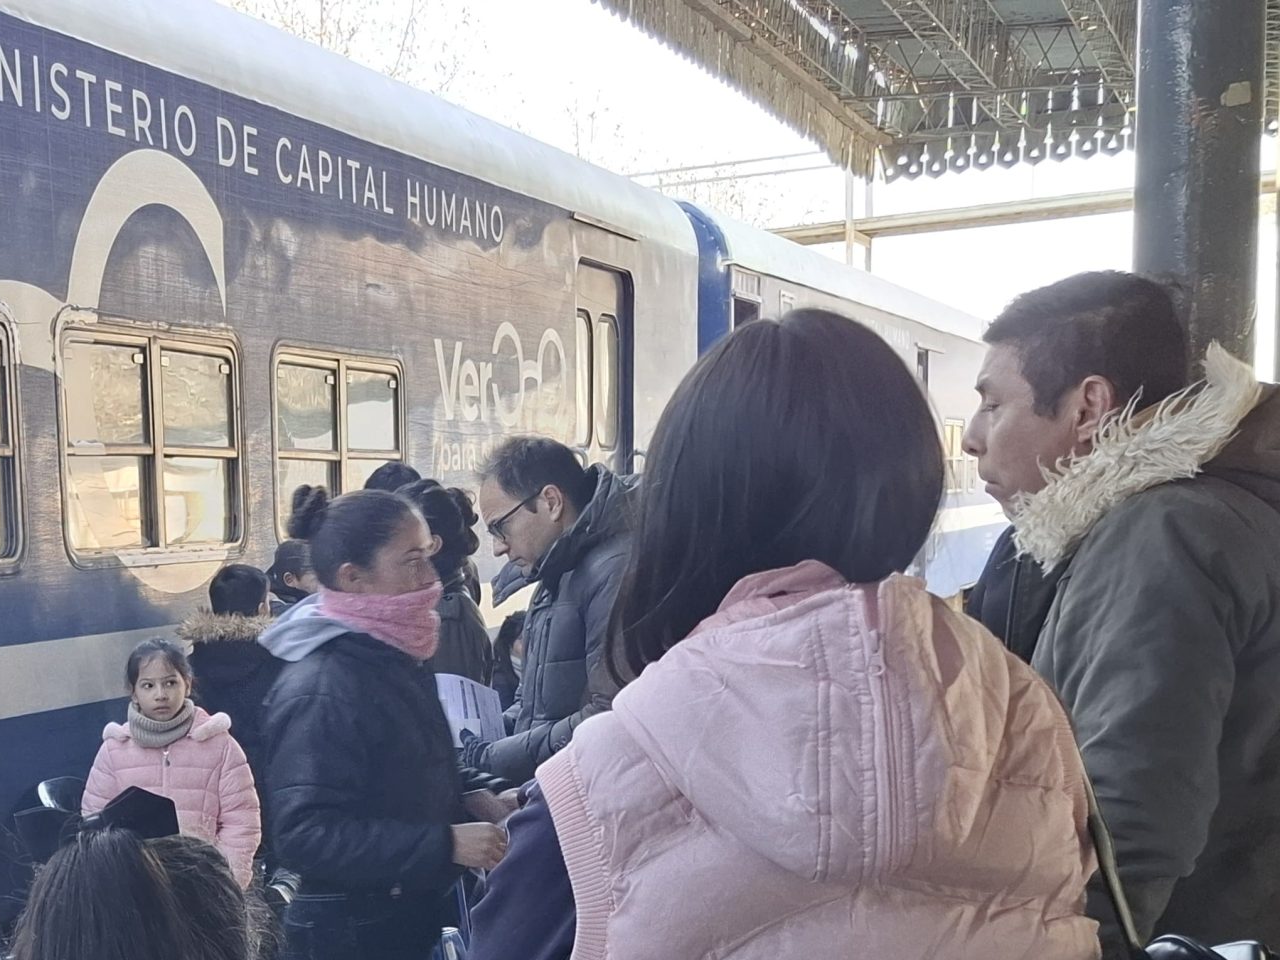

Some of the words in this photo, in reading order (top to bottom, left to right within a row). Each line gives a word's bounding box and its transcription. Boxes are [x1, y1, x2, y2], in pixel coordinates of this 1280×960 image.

[216, 115, 259, 176] DE
[275, 137, 394, 215] CAPITAL
[406, 177, 505, 243] HUMANO
